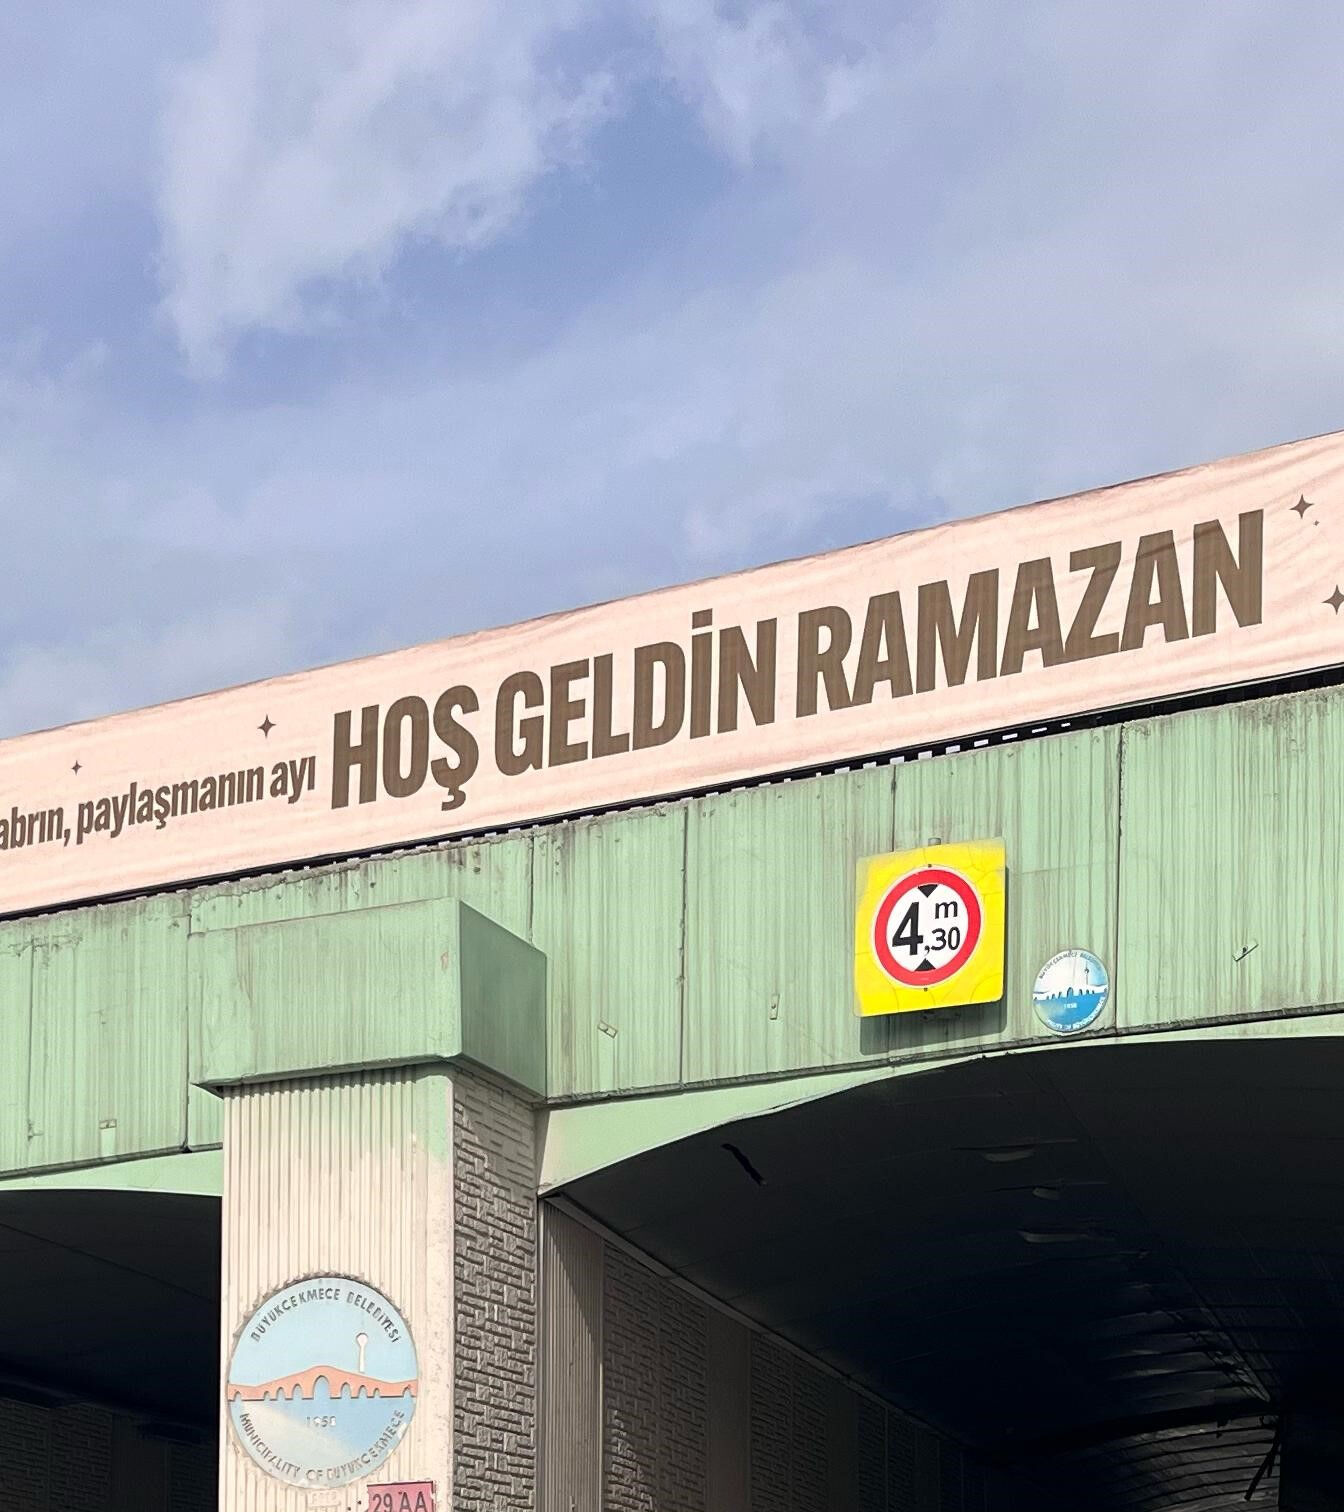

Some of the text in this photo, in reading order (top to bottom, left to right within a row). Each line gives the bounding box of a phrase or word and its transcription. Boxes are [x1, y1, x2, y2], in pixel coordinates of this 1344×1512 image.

[331, 509, 1265, 811] HOŞ GELDİN RAMAZAN
[77, 767, 263, 846] paylaşmanın
[271, 755, 317, 804] ayı
[935, 900, 959, 919] m
